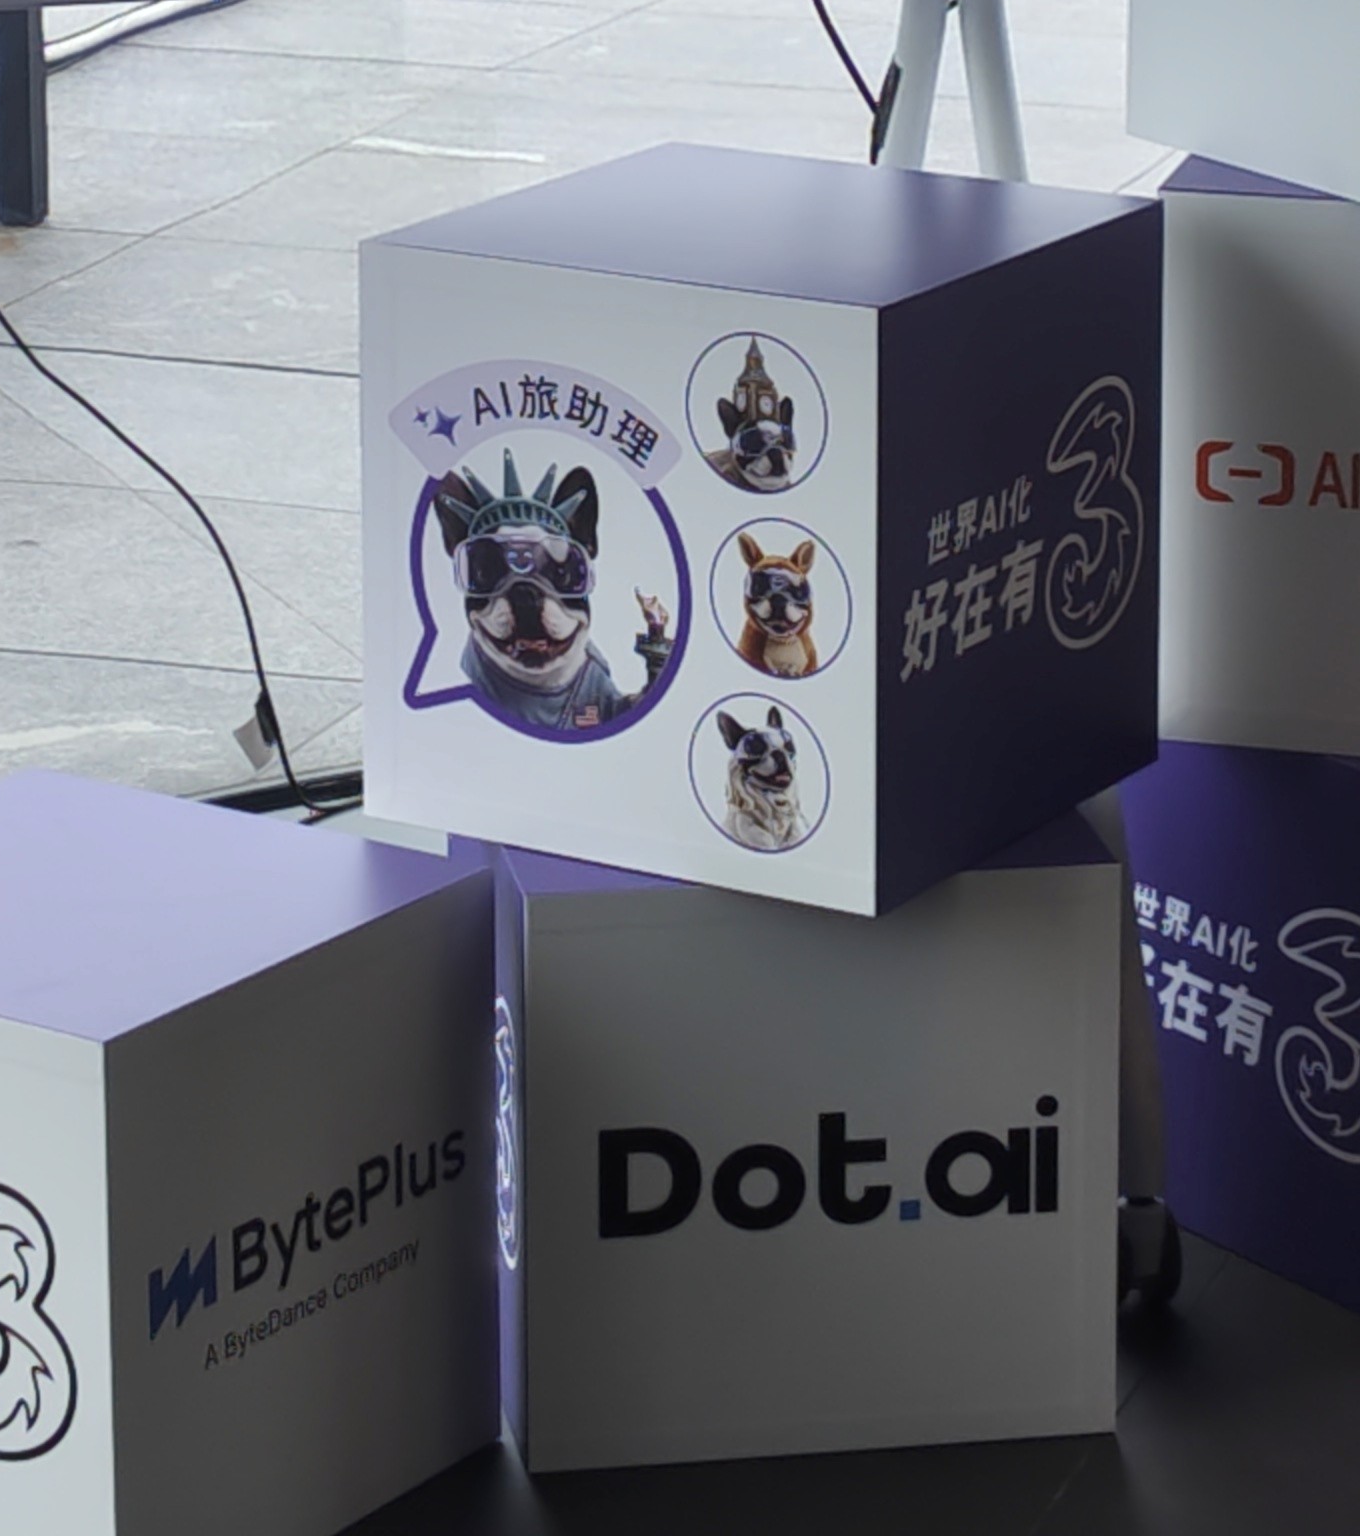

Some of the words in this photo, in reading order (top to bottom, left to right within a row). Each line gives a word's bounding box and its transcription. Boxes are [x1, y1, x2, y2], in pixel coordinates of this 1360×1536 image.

[470, 373, 660, 470] AI旅助理
[926, 474, 1033, 566] 世界AI化
[900, 537, 1044, 683] 好在有
[1133, 881, 1259, 973] 世界AI化
[232, 1129, 467, 1294] BytePlus
[598, 1094, 1060, 1240] Dot.ai
[204, 1343, 219, 1370] A
[224, 1287, 328, 1358] ByteDance
[334, 1239, 421, 1299] Company
